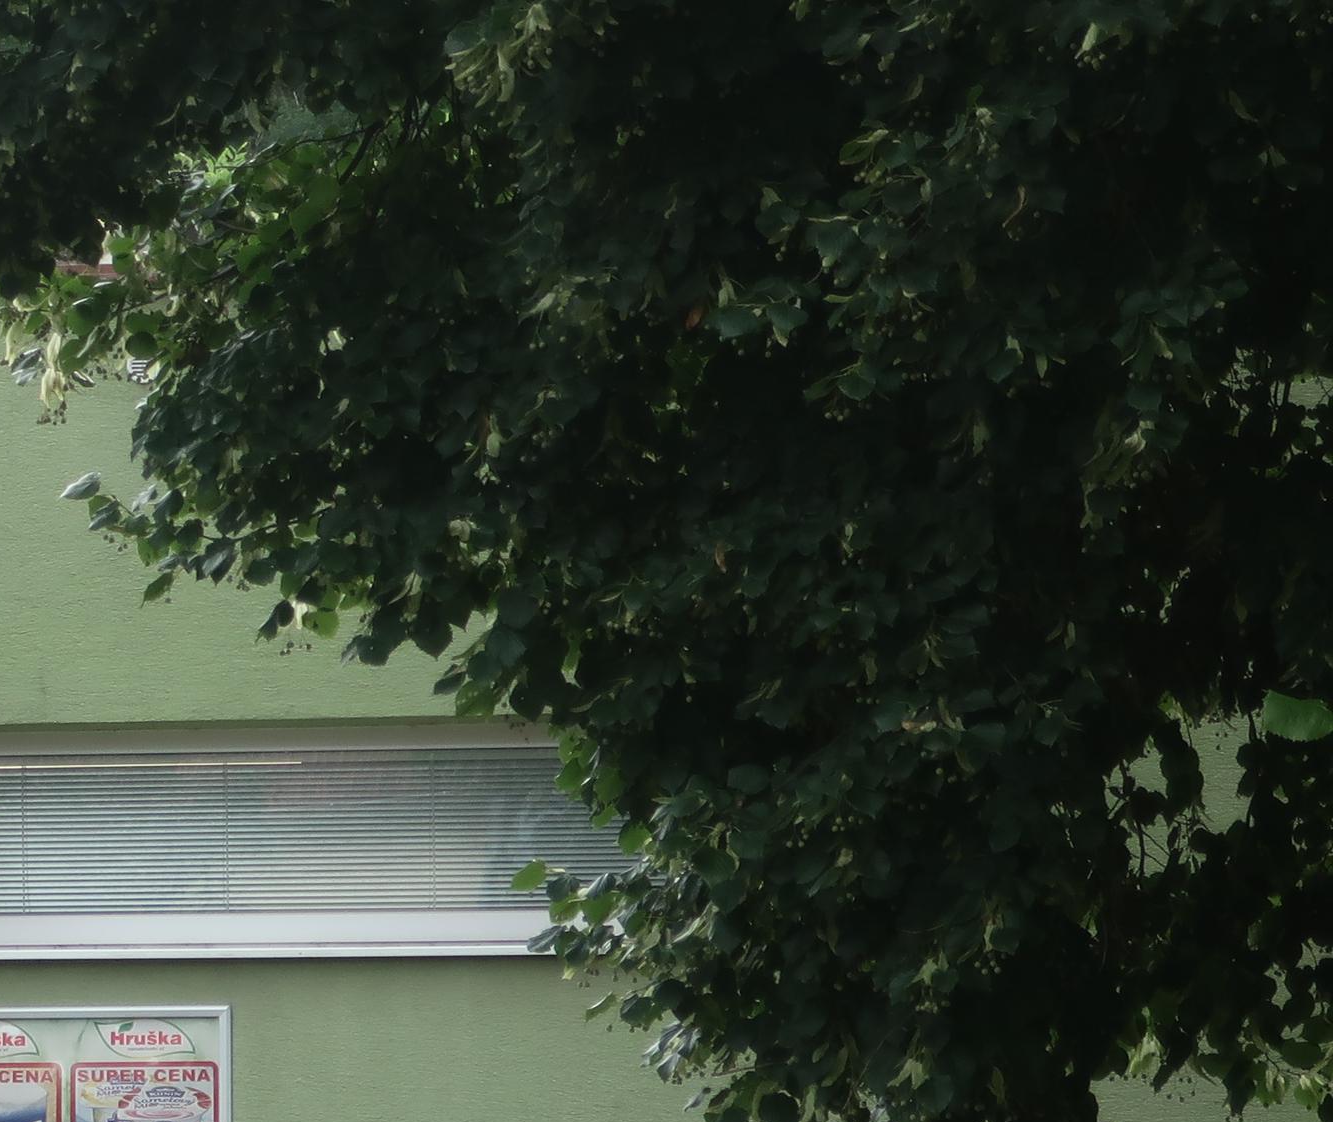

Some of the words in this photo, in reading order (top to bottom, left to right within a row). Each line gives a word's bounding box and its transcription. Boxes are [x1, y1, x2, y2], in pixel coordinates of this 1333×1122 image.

[110, 1030, 182, 1046] Hruška
[78, 1070, 146, 1082] SUPER
[154, 1069, 211, 1082] CENA
